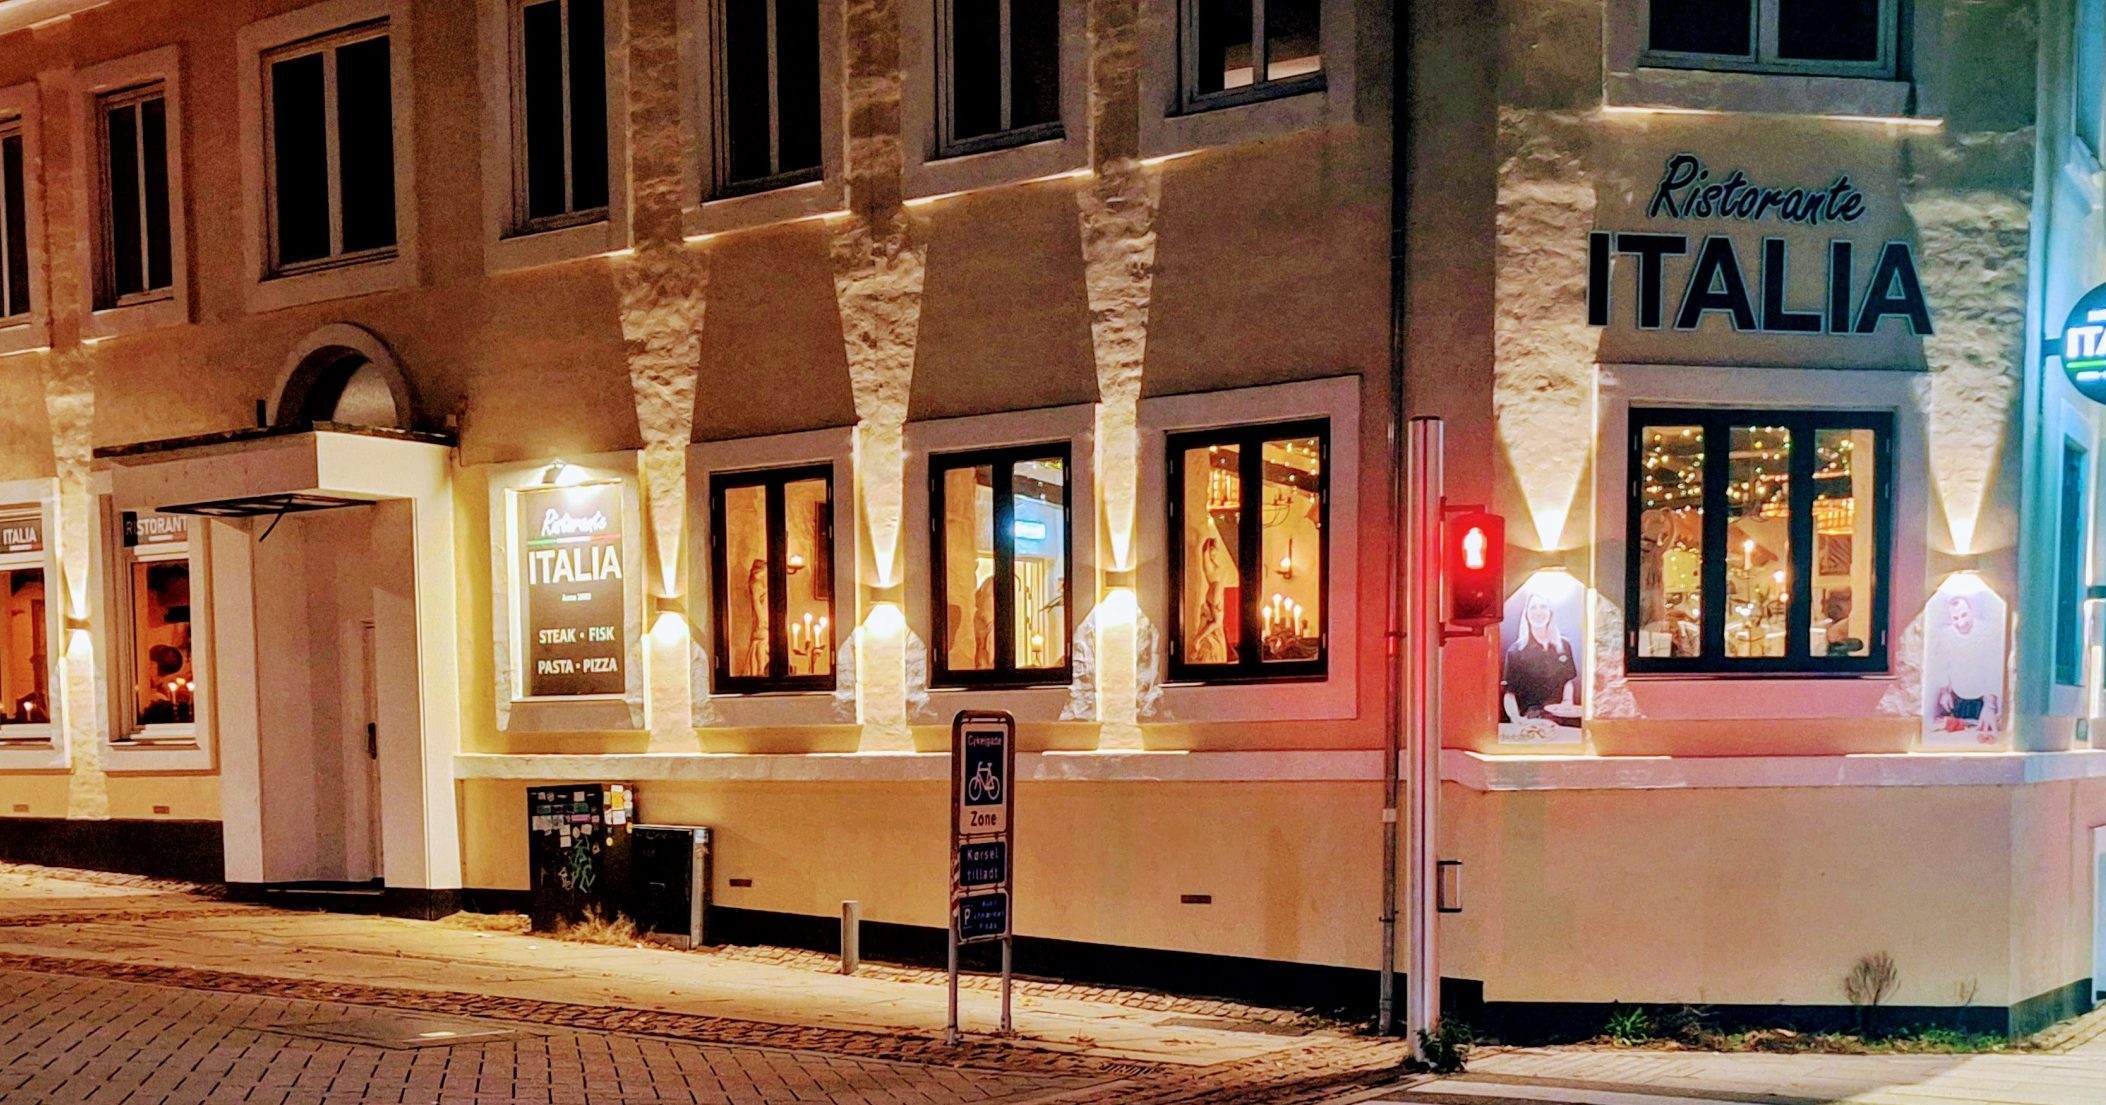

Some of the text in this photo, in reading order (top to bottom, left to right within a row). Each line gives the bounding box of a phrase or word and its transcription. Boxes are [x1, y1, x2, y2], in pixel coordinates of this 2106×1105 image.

[1649, 153, 1867, 225] Ristorante
[1587, 230, 1934, 336] ITALIA
[3, 527, 37, 544] ITALIA
[528, 545, 622, 585] ITALIA
[539, 626, 615, 644] STEAK FISK
[538, 657, 618, 675] PASTA PIZZA
[970, 811, 997, 826] Zone
